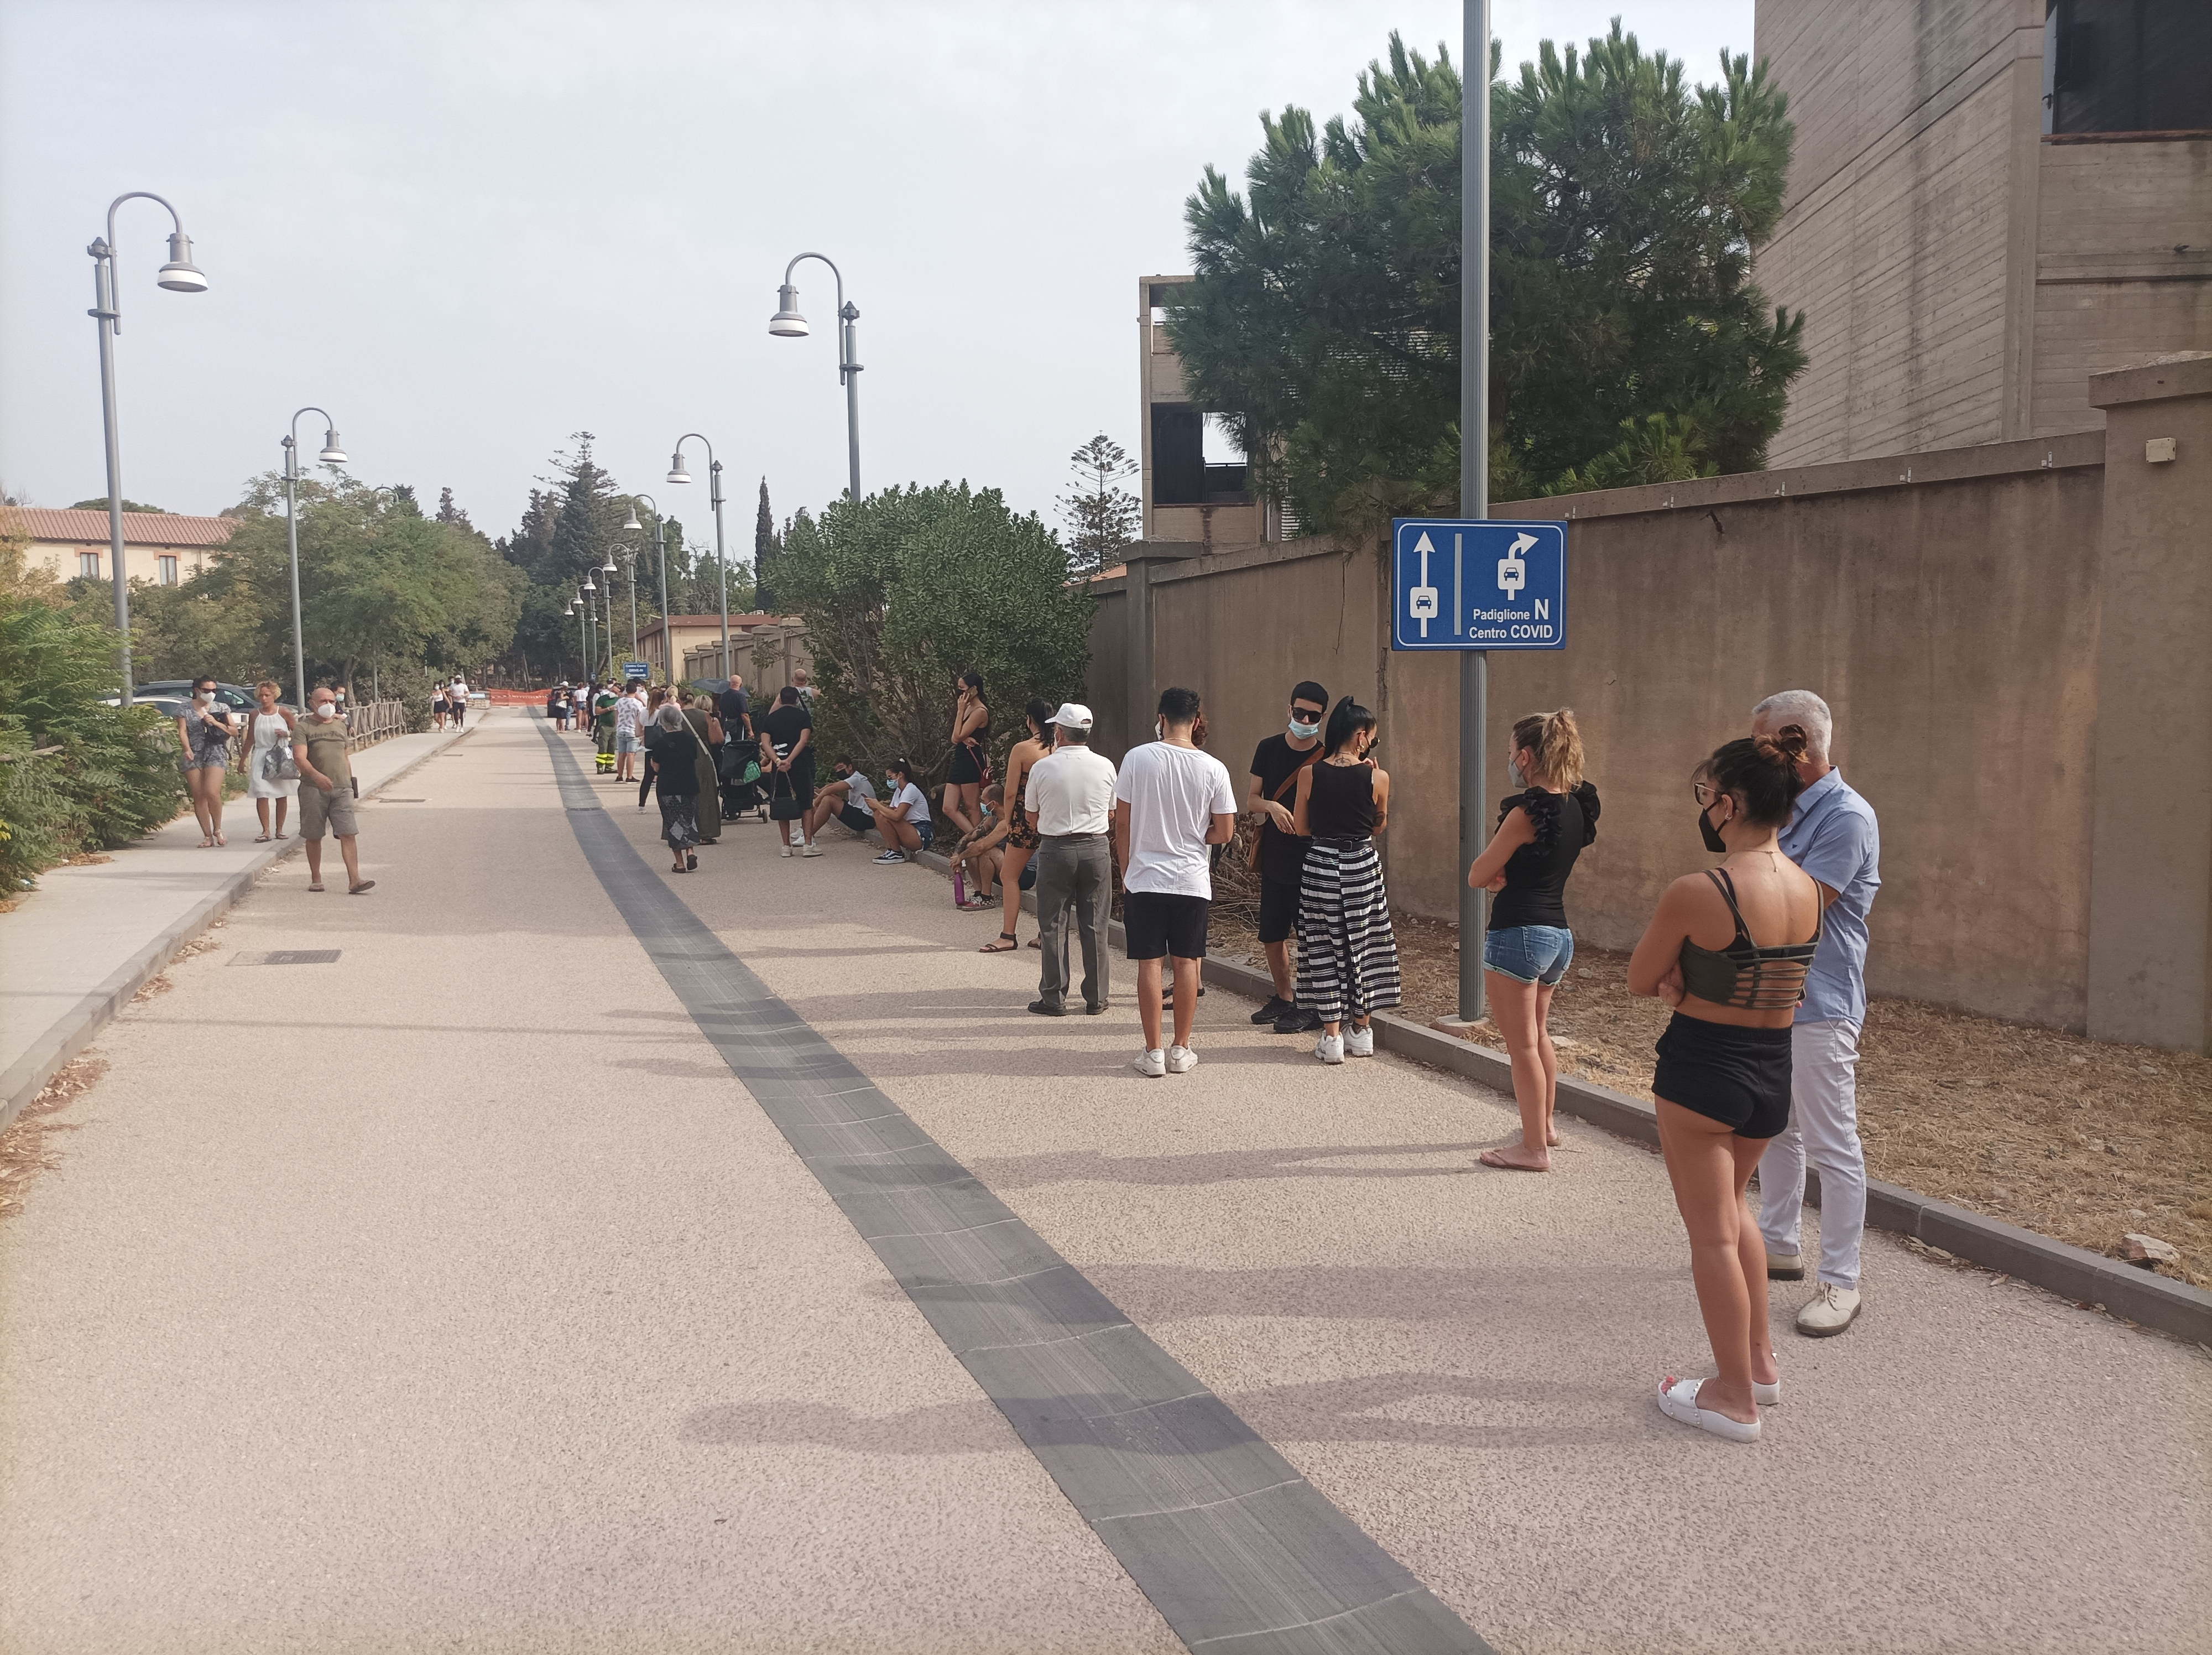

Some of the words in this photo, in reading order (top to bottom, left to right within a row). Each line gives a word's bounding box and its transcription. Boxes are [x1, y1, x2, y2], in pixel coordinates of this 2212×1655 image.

[1473, 609, 1530, 622] Padiglione
[1535, 598, 1548, 620] N
[1469, 627, 1506, 638] Centro
[1510, 625, 1553, 638] COVID
